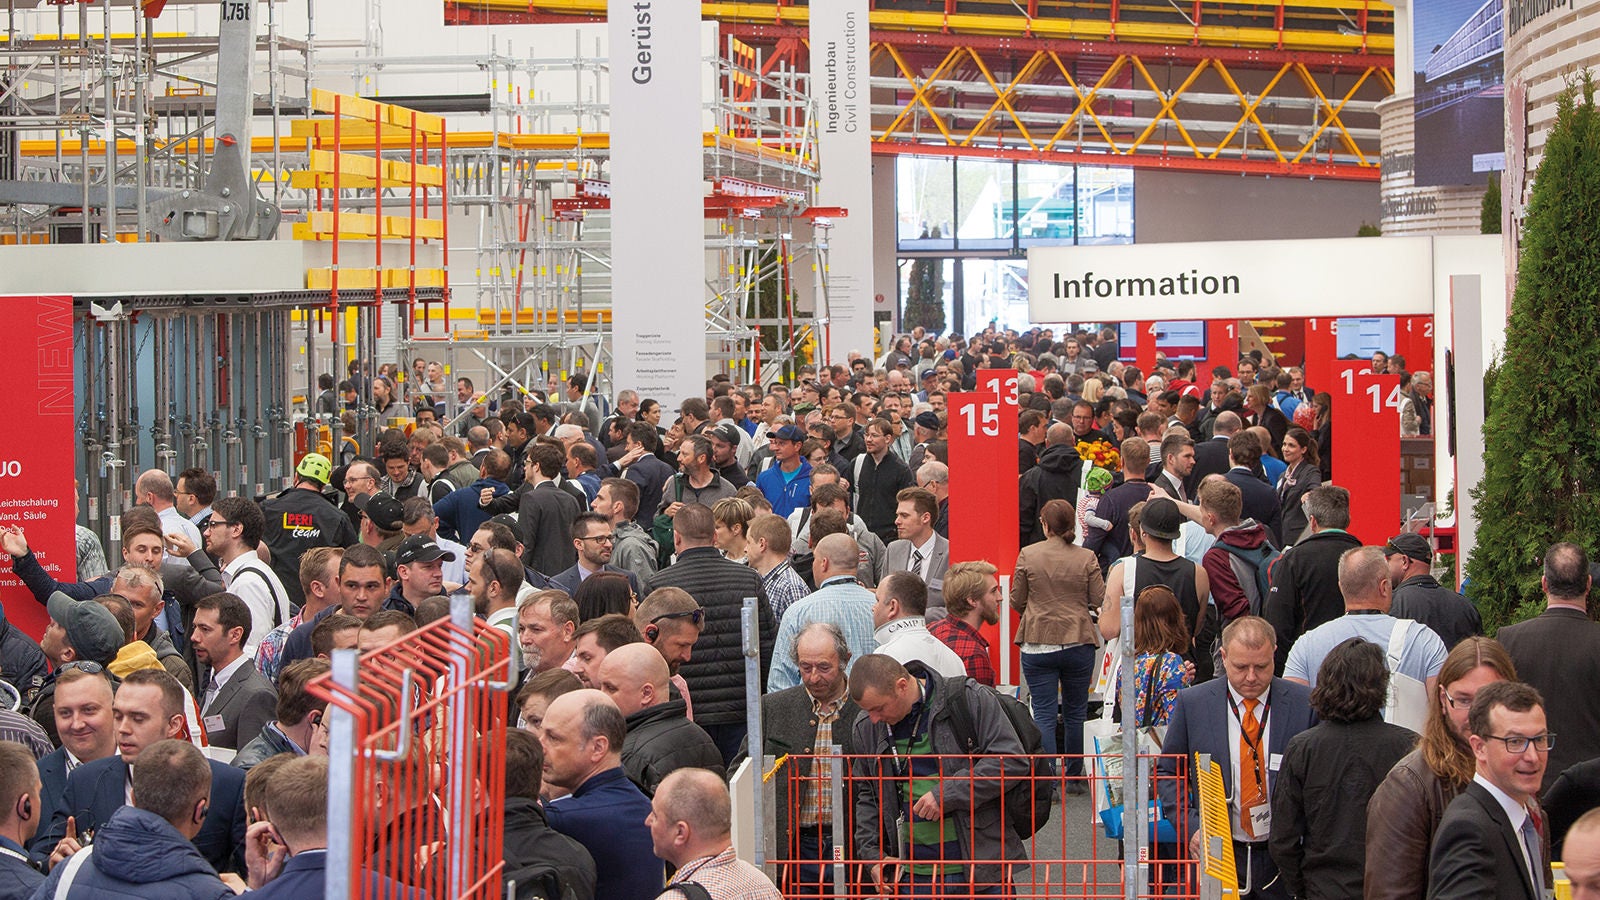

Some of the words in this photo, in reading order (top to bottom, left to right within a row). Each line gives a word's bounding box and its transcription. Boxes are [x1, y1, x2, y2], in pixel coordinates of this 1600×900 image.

[222, 0, 249, 22] 1,75t
[631, 2, 652, 85] Gerüst
[843, 11, 857, 99] Construction
[825, 41, 840, 133] Ingenieurbau
[844, 104, 857, 133] Civil
[1053, 269, 1240, 298] Information
[1226, 324, 1234, 339] 1
[1423, 322, 1433, 337] 2
[37, 296, 74, 415] NEW
[986, 377, 1019, 405] 13
[1366, 384, 1401, 413] 14
[960, 403, 999, 436] 15
[0, 498, 59, 507] eichtschalung
[23, 510, 47, 520] Säule
[287, 513, 313, 526] PERI
[292, 524, 321, 539] team
[888, 619, 919, 633] CAMP
